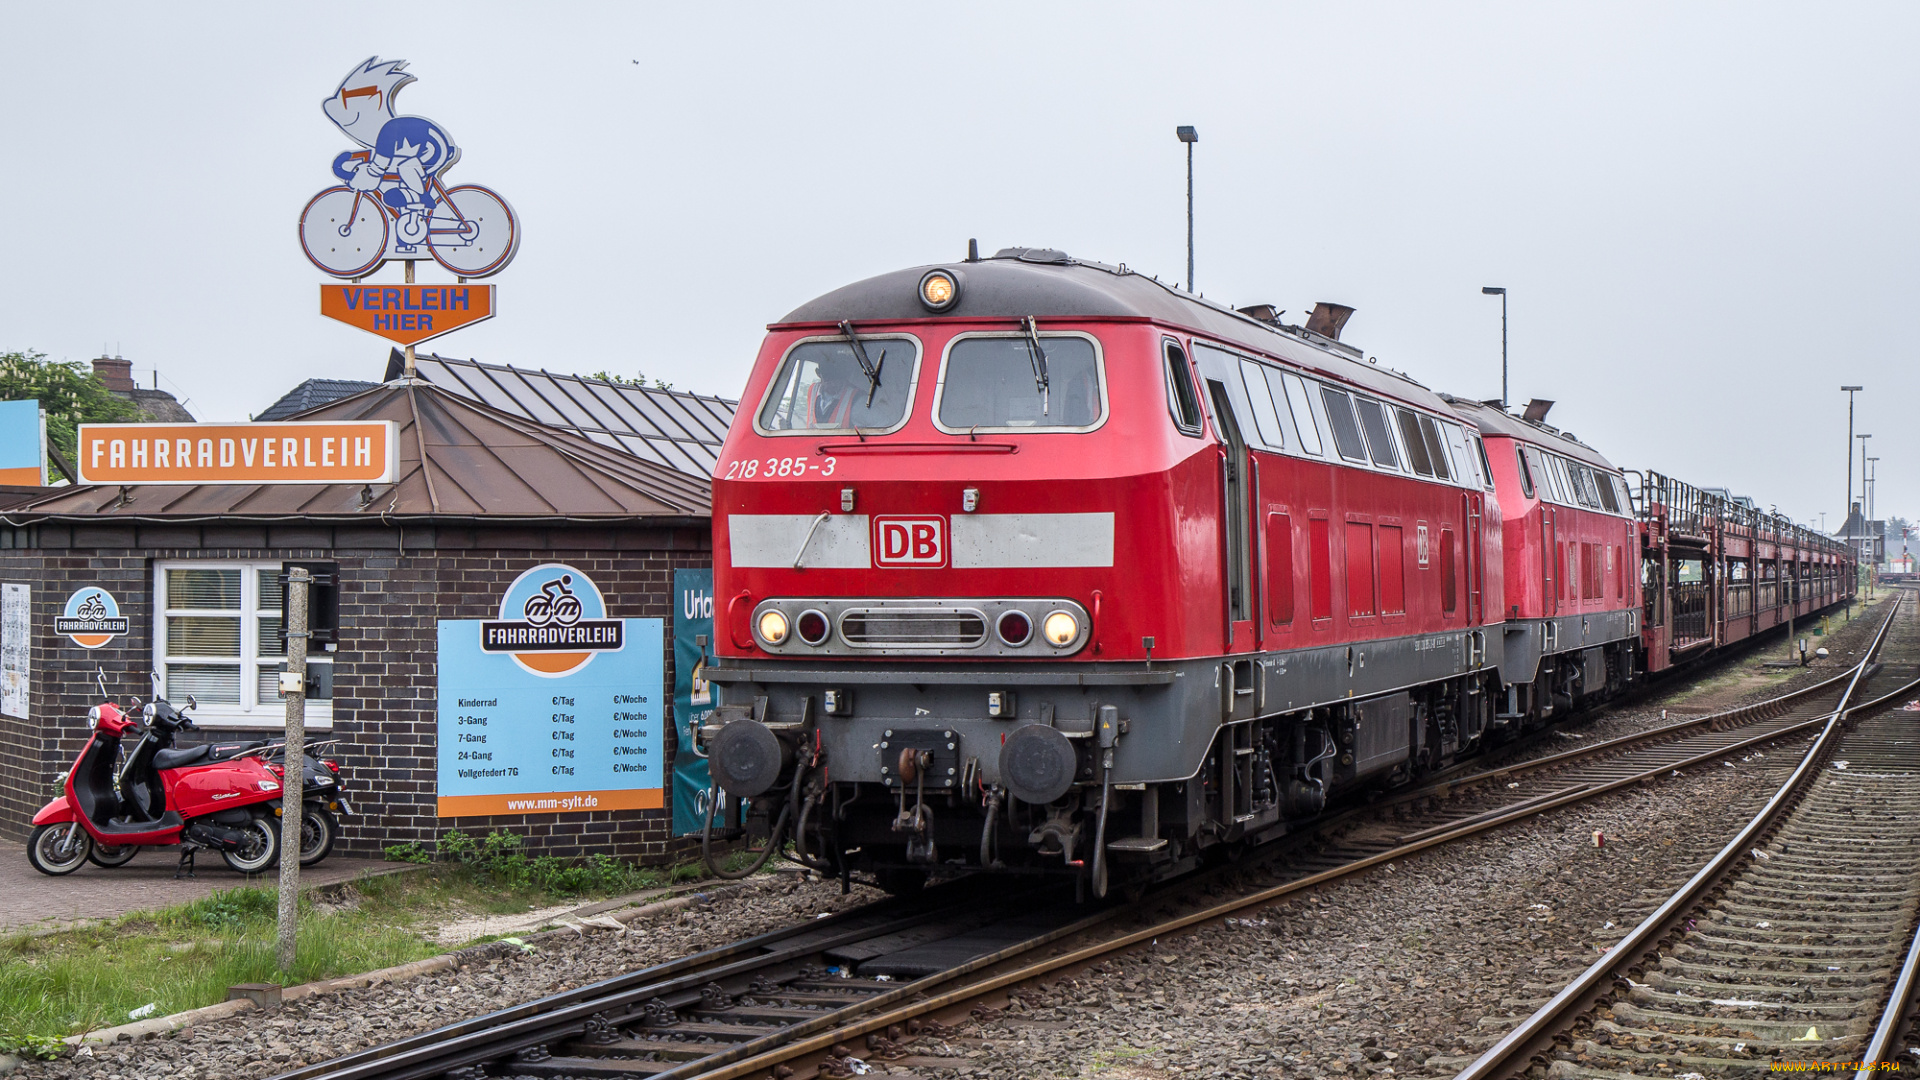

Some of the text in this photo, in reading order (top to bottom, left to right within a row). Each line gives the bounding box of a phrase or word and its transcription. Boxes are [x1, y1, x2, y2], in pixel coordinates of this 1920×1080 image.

[342, 288, 469, 311] VERLEIH
[373, 314, 433, 331] HIER
[91, 436, 372, 469] FAHRRADVERLEIH
[724, 456, 837, 481] 218 385-3
[883, 524, 938, 559] DB
[1419, 528, 1427, 560] DB
[684, 588, 714, 620] Urla
[58, 620, 126, 632] FAHRRADVERLEIH
[488, 626, 617, 645] FAHRRADVERLEIH
[1214, 665, 1219, 688] 2
[457, 697, 498, 708] Kinderrad
[551, 696, 575, 707] €/Tag
[613, 695, 648, 704] €/Woche
[457, 715, 488, 727] 3-Gang
[551, 714, 575, 725] €/Tag
[613, 712, 648, 721] €/Woche
[457, 733, 487, 744] 7-Gang
[551, 731, 575, 742] €/Tag
[613, 729, 648, 738] €/Woche
[551, 748, 575, 759] €/Tag
[613, 746, 648, 755] €/Woche
[457, 751, 493, 762] 24-Gang
[457, 767, 519, 779] Vollgefedert 7G
[551, 766, 575, 777] €/Tag
[613, 764, 648, 773] €/Woche
[507, 794, 598, 810] www.mm-sylt.de
